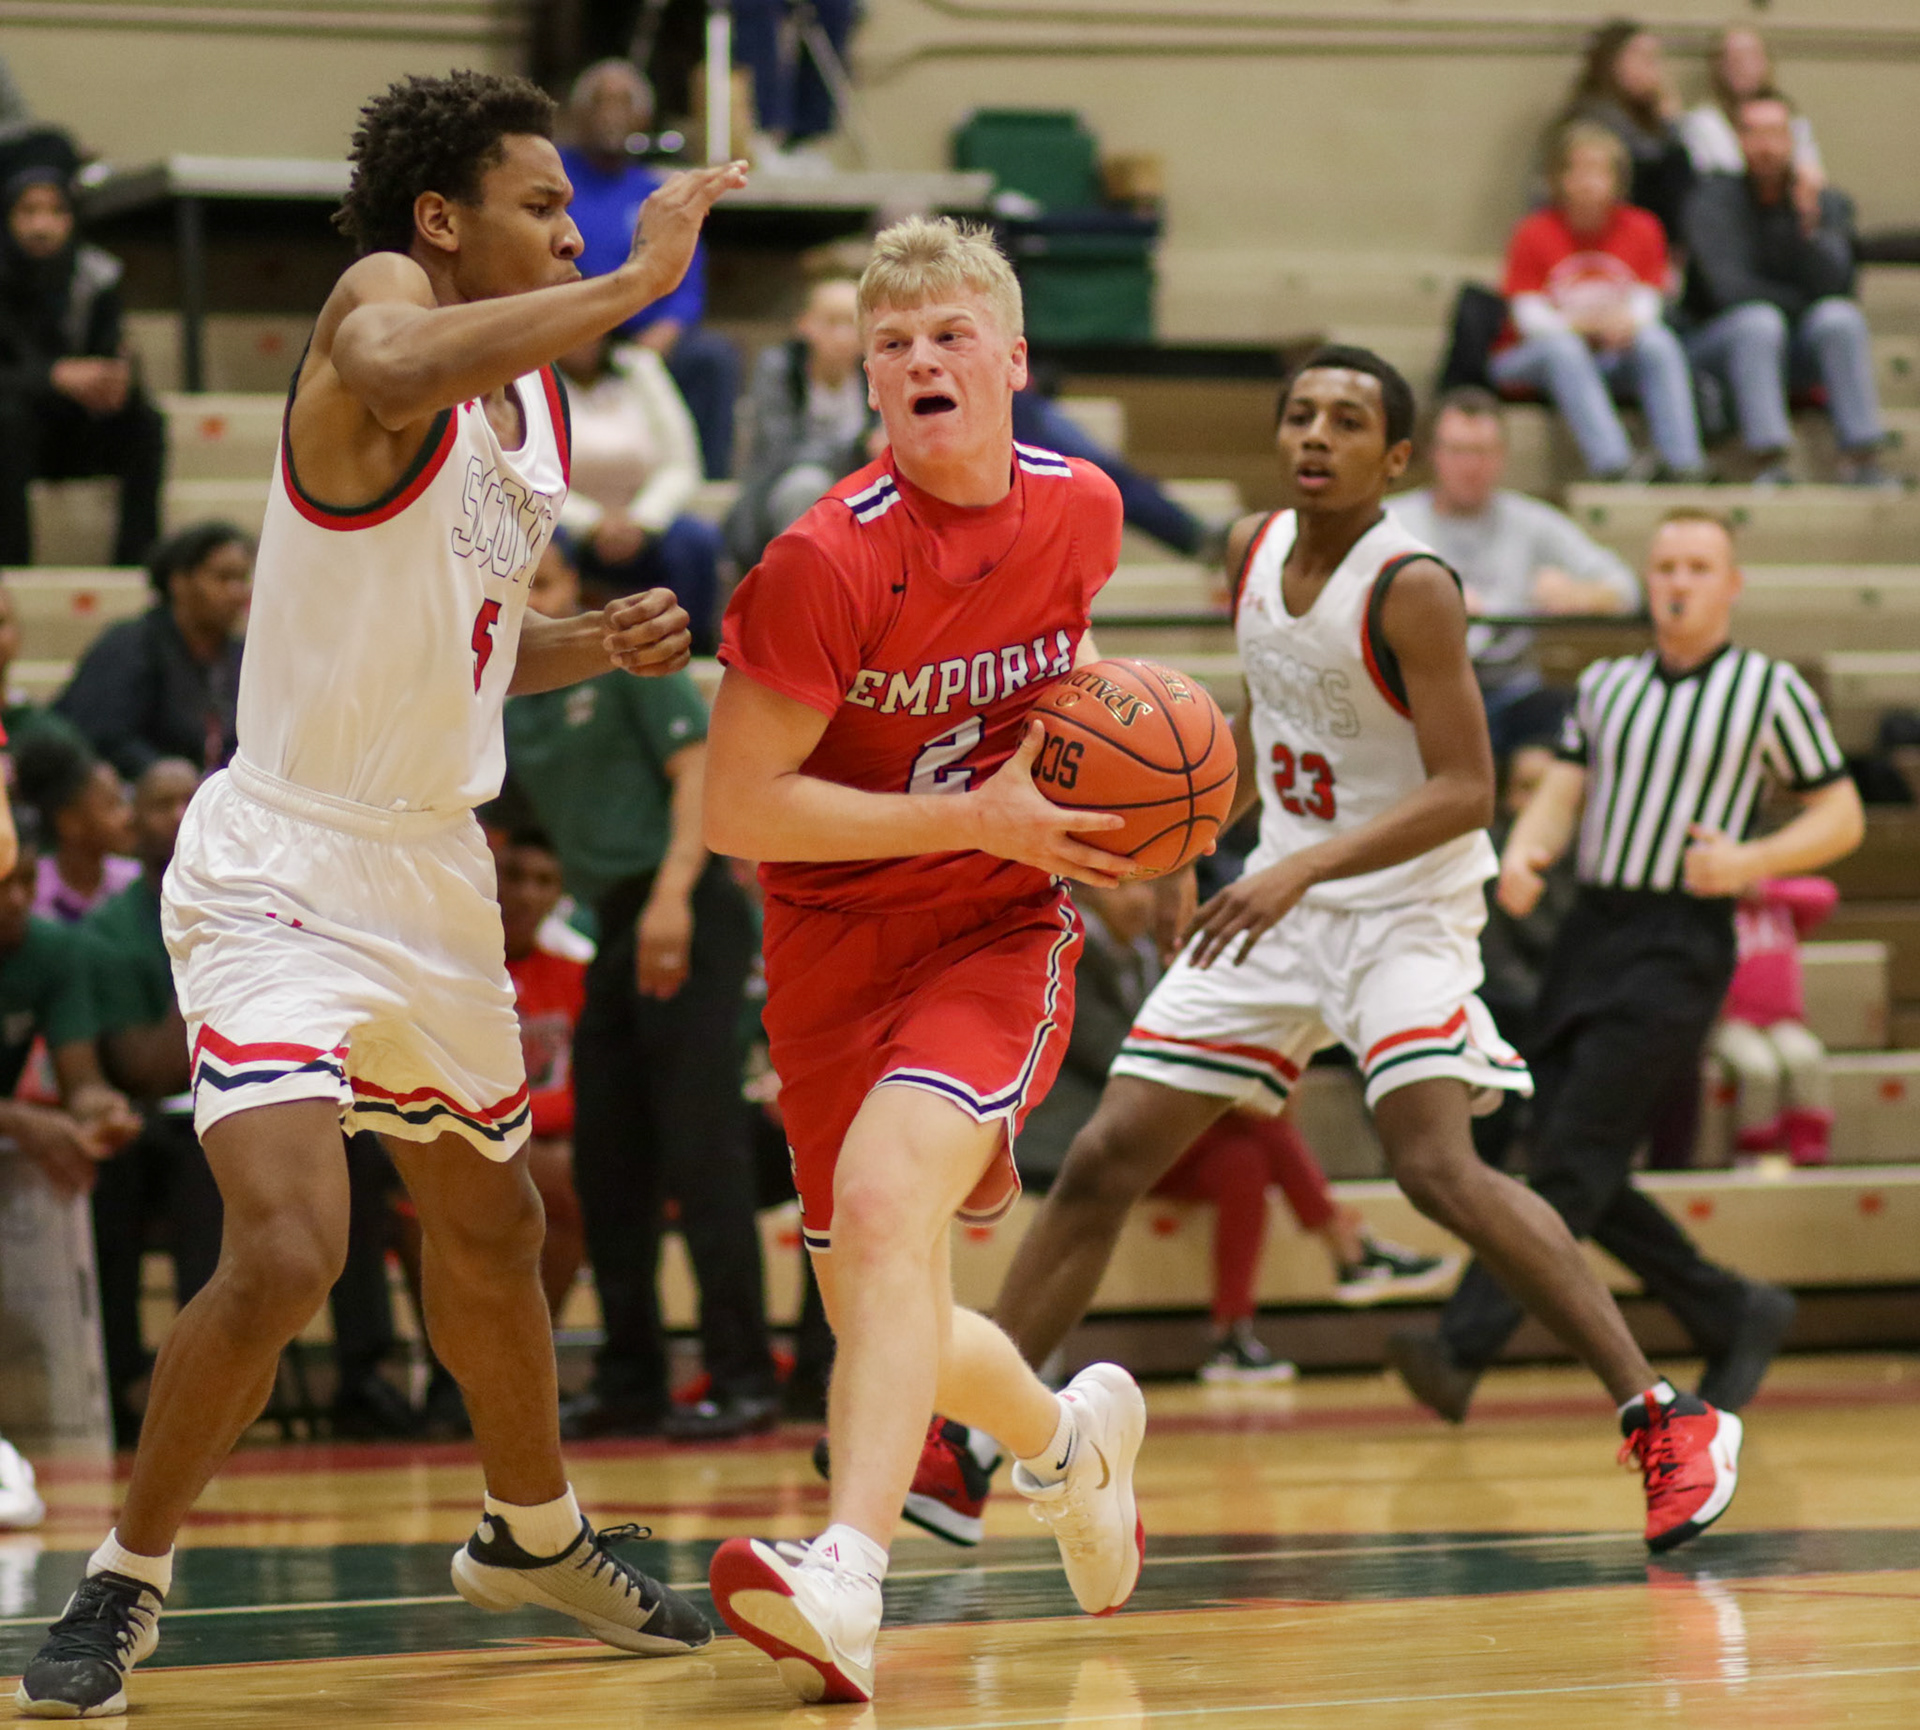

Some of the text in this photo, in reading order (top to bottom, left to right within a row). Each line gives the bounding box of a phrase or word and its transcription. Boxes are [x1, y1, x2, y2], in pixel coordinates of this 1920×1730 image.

[471, 597, 502, 696] 5
[844, 628, 1072, 717] EMPORIA
[905, 713, 987, 796] 2
[1270, 741, 1337, 821] 23
